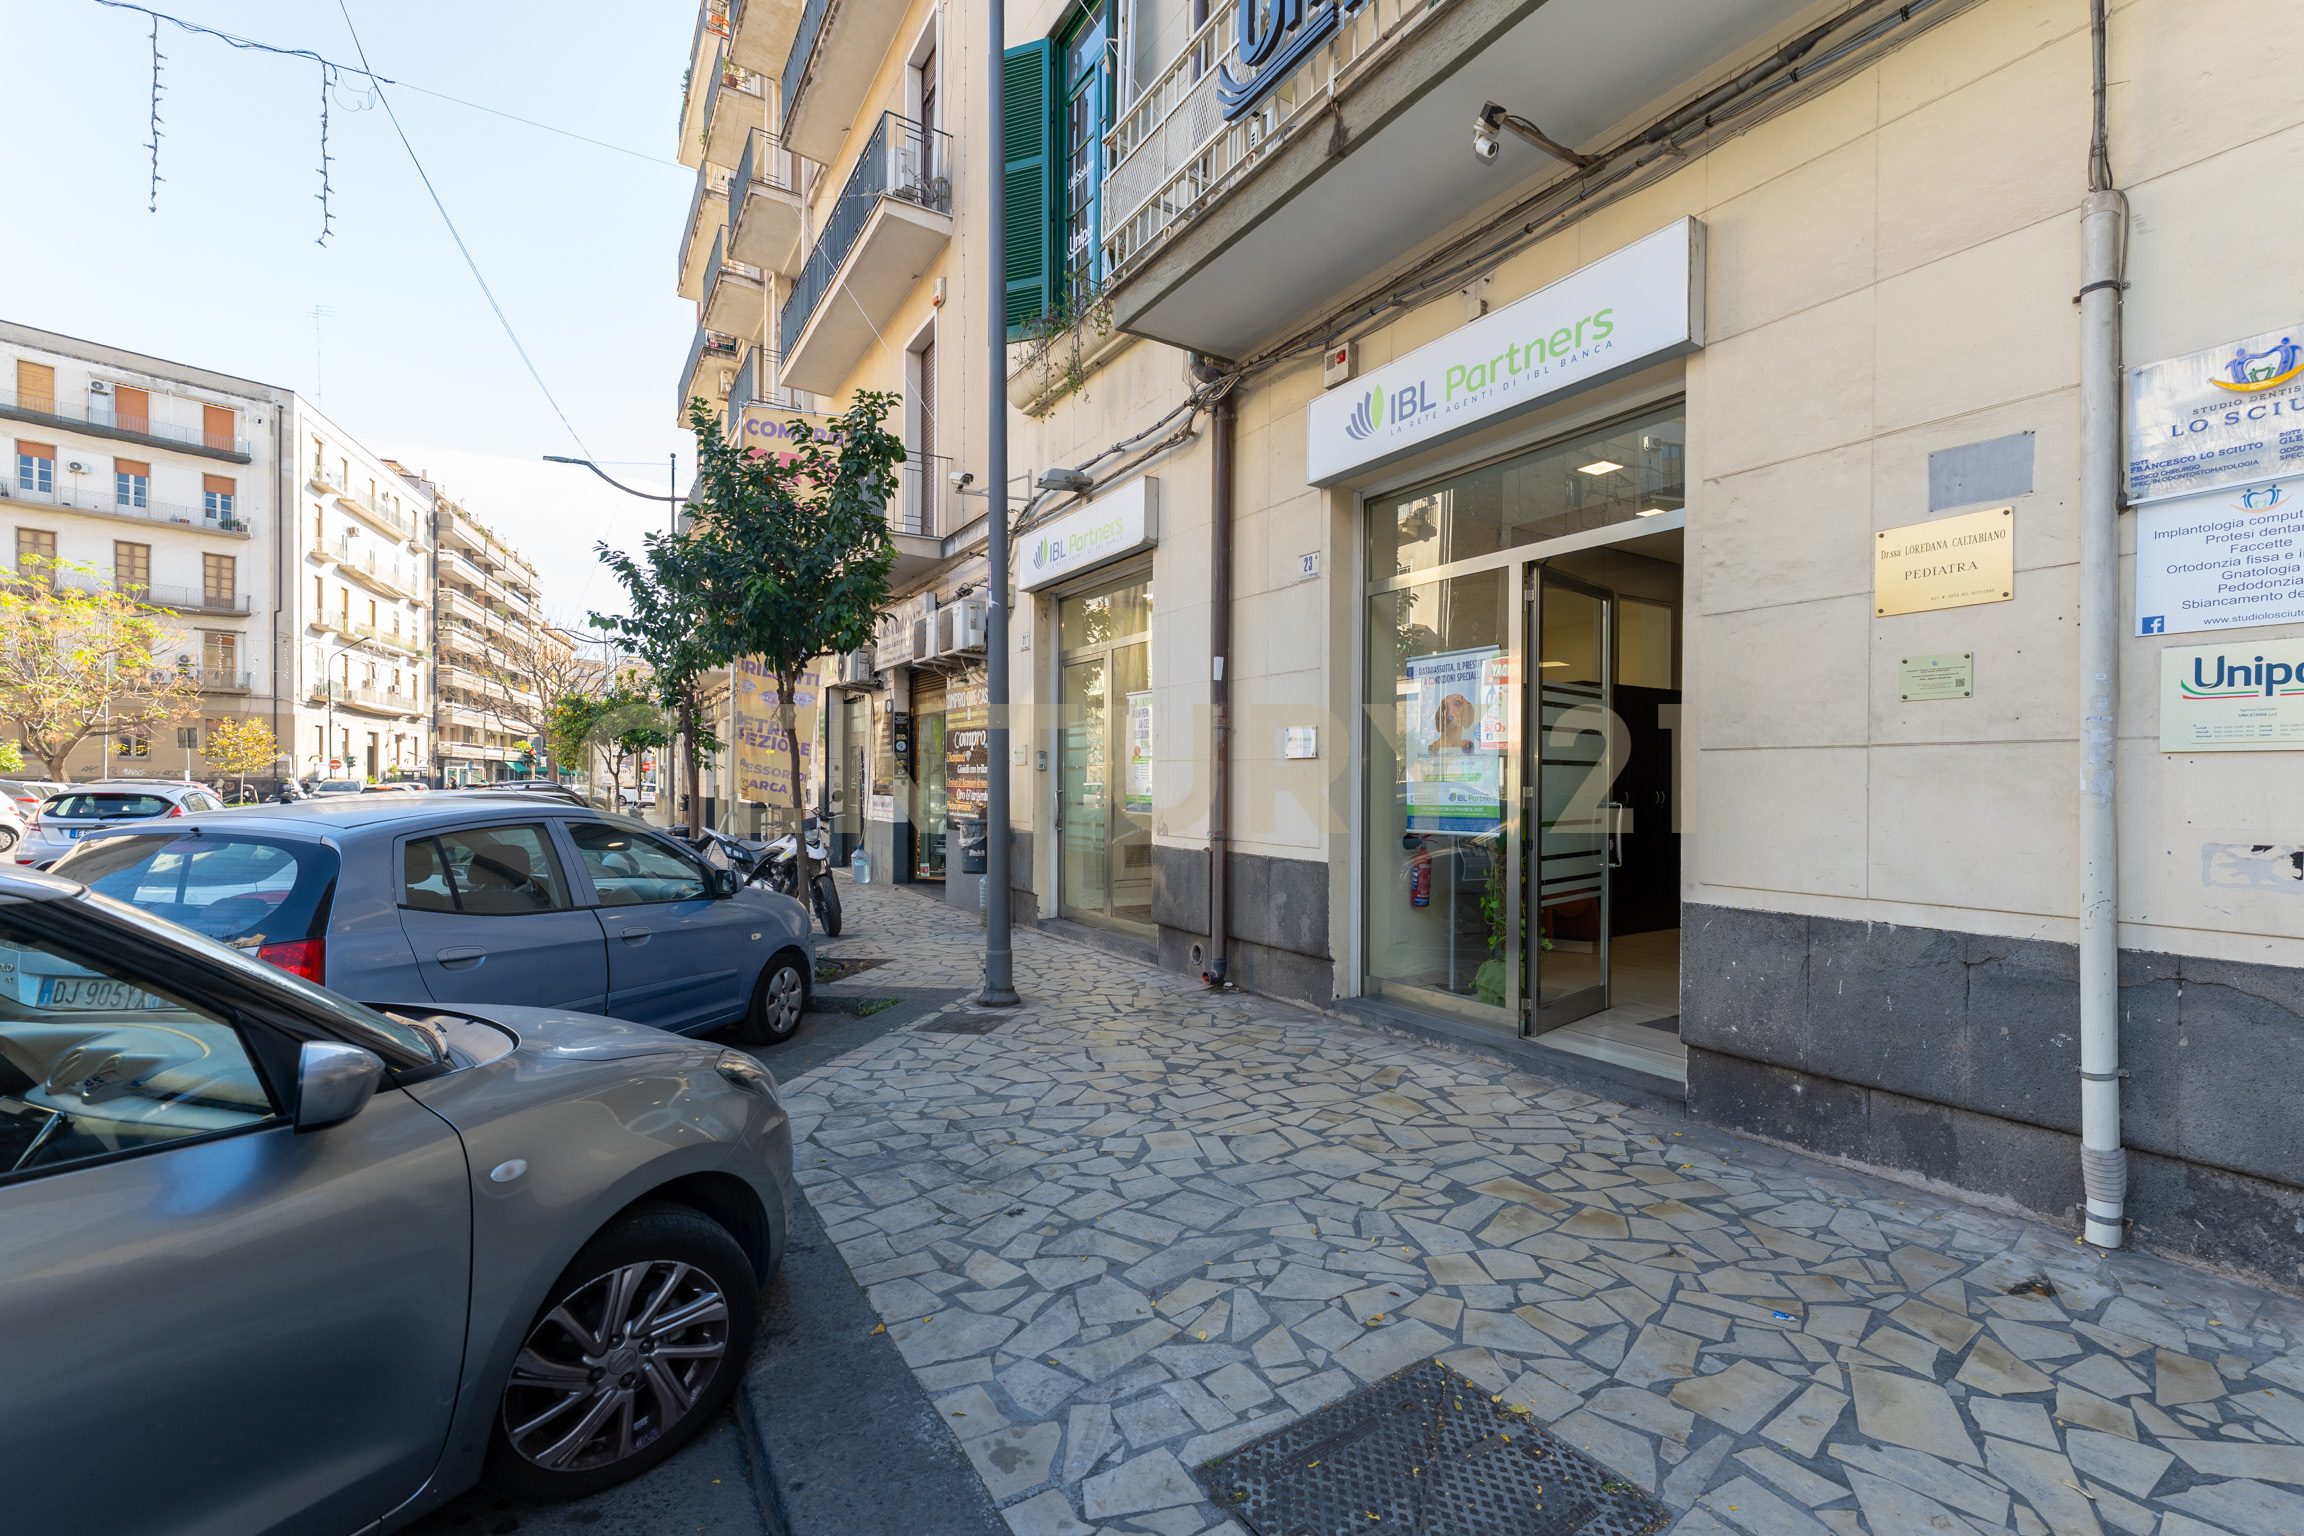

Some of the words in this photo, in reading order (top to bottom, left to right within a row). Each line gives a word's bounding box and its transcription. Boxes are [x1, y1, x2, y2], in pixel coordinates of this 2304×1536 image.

[1068, 160, 1094, 190] UniSalute
[1390, 380, 1437, 425] IBL
[1446, 307, 1615, 402] Partners
[1390, 424, 1403, 437] LA
[1410, 411, 1438, 429] RETE
[1445, 389, 1495, 414] AGENTI
[1502, 379, 1517, 391] DI
[1527, 368, 1549, 383] IBL
[1560, 340, 1614, 367] BANCA
[2192, 399, 2243, 415] STUDIO
[2249, 384, 2304, 402] DENTIS
[746, 418, 845, 447] COMRO
[2171, 418, 2209, 437] LO
[2130, 455, 2196, 474] FRANCESCO
[2200, 451, 2215, 460] LO
[2218, 441, 2264, 457] SCIUTO
[2130, 471, 2159, 482] MEDICO
[2160, 463, 2200, 477] CHIRURGO
[2161, 459, 2259, 483] ODONTOSTOMATOLOGIA
[2154, 519, 2244, 539] Implantologia
[2205, 529, 2254, 544] Protesi
[1049, 539, 1066, 563] IBL
[1069, 517, 1124, 554] Partners
[1881, 549, 1901, 560] Dr.ssa
[1905, 540, 1948, 556] LOREDANA
[1952, 529, 2006, 547] CALTABIANO
[2230, 539, 2293, 553] Faccette
[1303, 555, 1313, 572] 23
[1905, 561, 1978, 580] PEDIATRA
[2166, 559, 2241, 574] Ortodonzia
[2246, 553, 2279, 564] fissa
[2285, 552, 2294, 560] e
[2221, 564, 2300, 580] Gnatologia
[2218, 576, 2304, 593] Pedodonzia
[2182, 592, 2283, 610] Sbiancamento
[954, 730, 986, 751] Compro
[53, 981, 81, 1004] DJ
